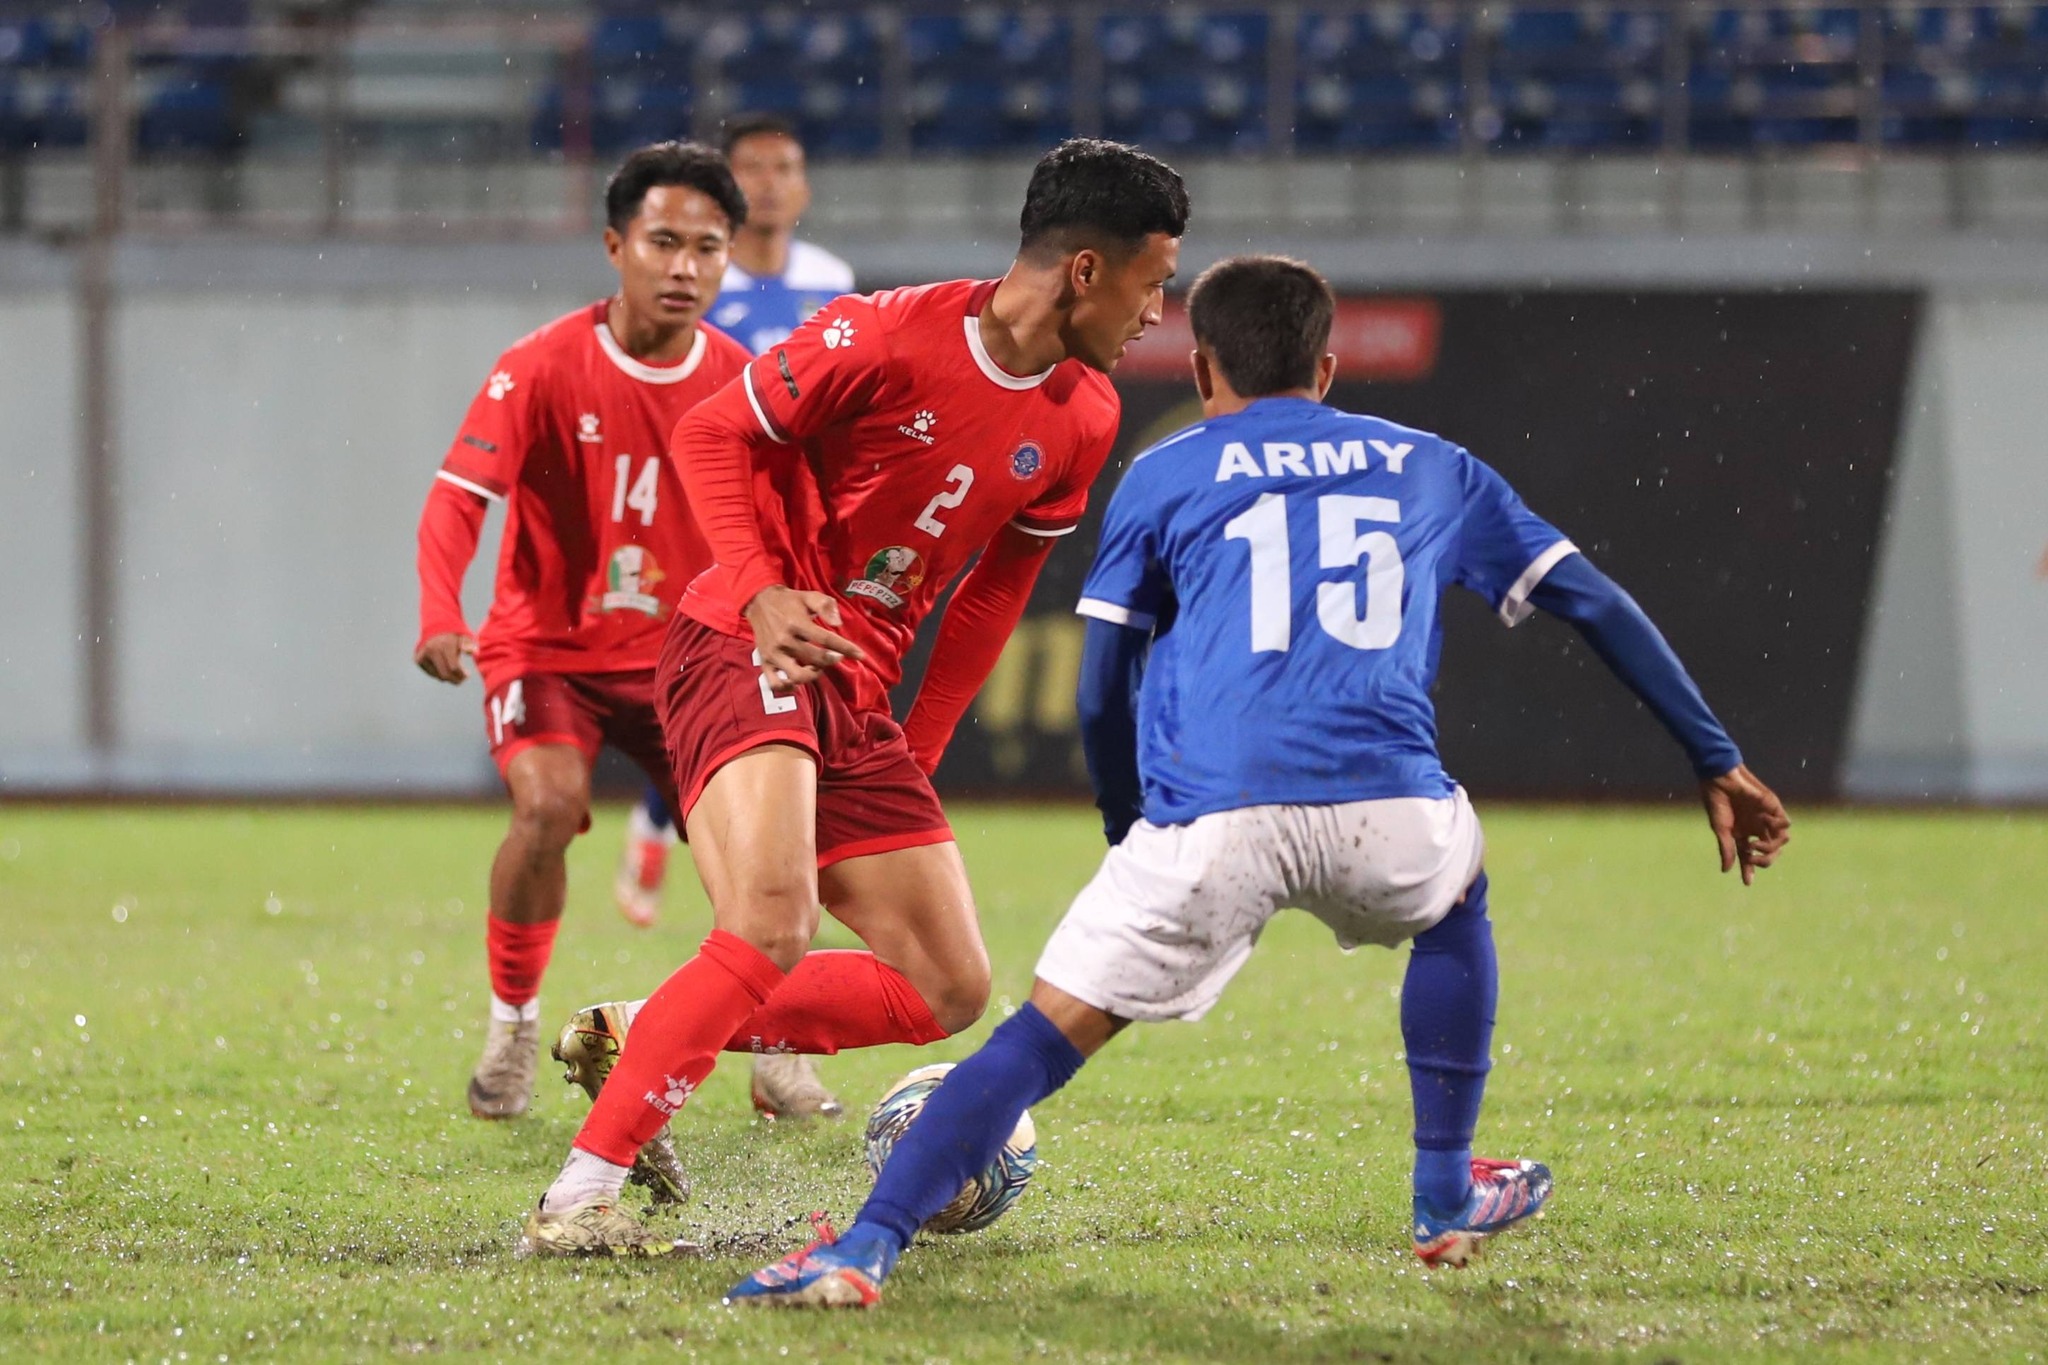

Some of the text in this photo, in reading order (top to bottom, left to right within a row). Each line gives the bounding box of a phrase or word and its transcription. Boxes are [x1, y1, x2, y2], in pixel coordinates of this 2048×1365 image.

[897, 424, 935, 445] KELME
[1215, 440, 1415, 482] ARMY
[611, 453, 660, 526] 14
[913, 463, 975, 539] 2
[1224, 492, 1405, 653] 15
[490, 678, 527, 746] 14
[643, 1090, 680, 1117] KELM
